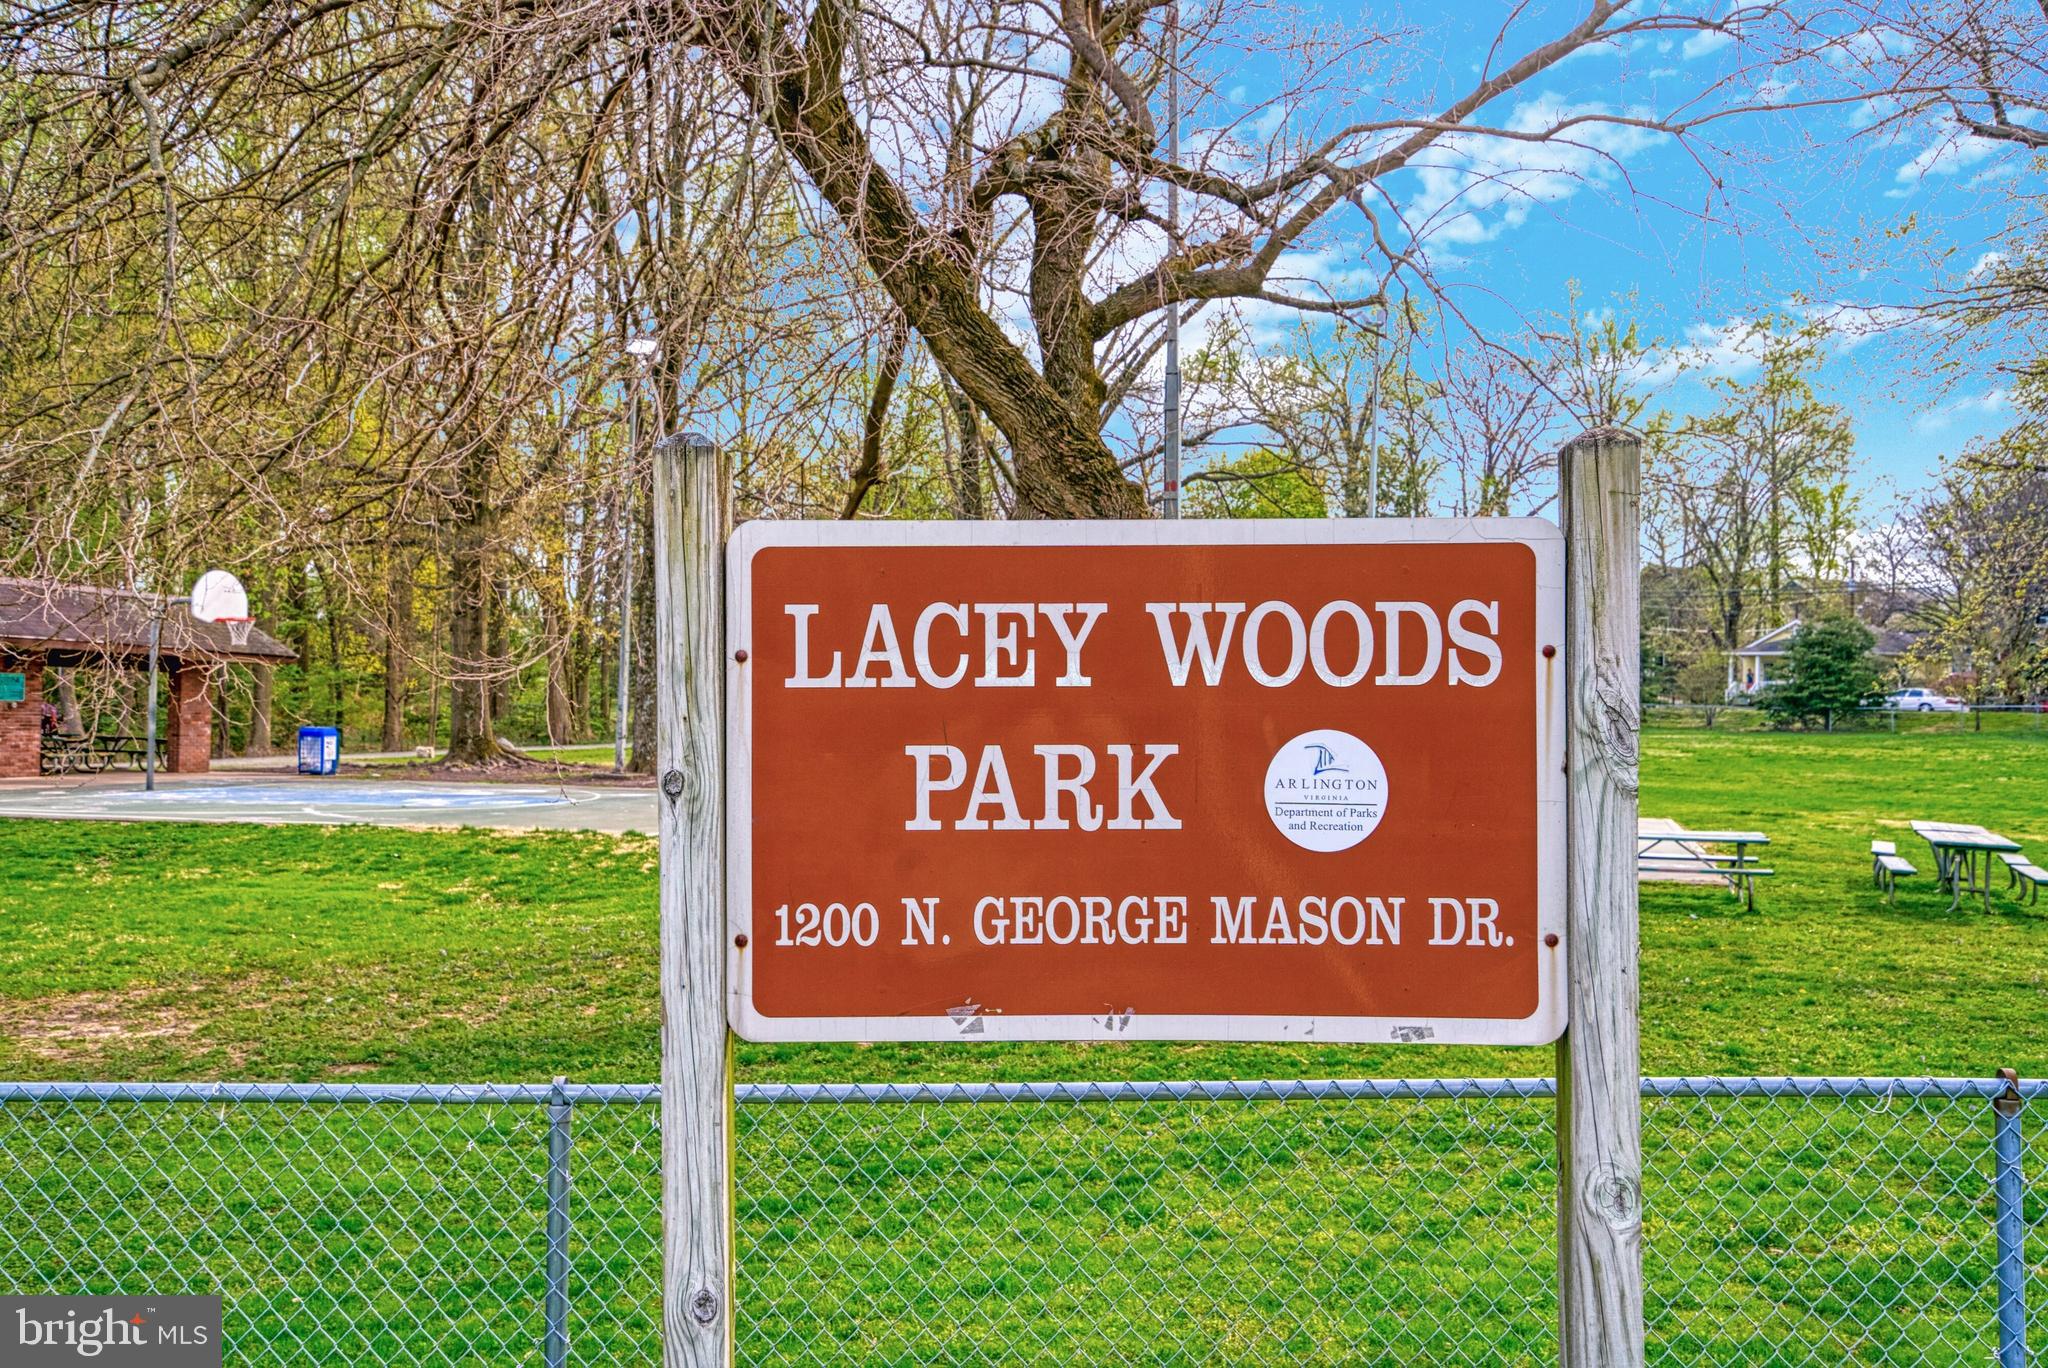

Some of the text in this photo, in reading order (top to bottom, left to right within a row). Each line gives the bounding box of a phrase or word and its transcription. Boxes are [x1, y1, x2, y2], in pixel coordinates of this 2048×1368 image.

[784, 600, 1503, 689] LACEY WOODS
[904, 744, 1183, 832] PARK
[1275, 778, 1377, 791] ARLINGTON
[1275, 807, 1378, 819] Department of Parks
[1288, 821, 1363, 832] and Recreation
[775, 895, 1514, 948] 1200 N. GEORGE MASON DR.
